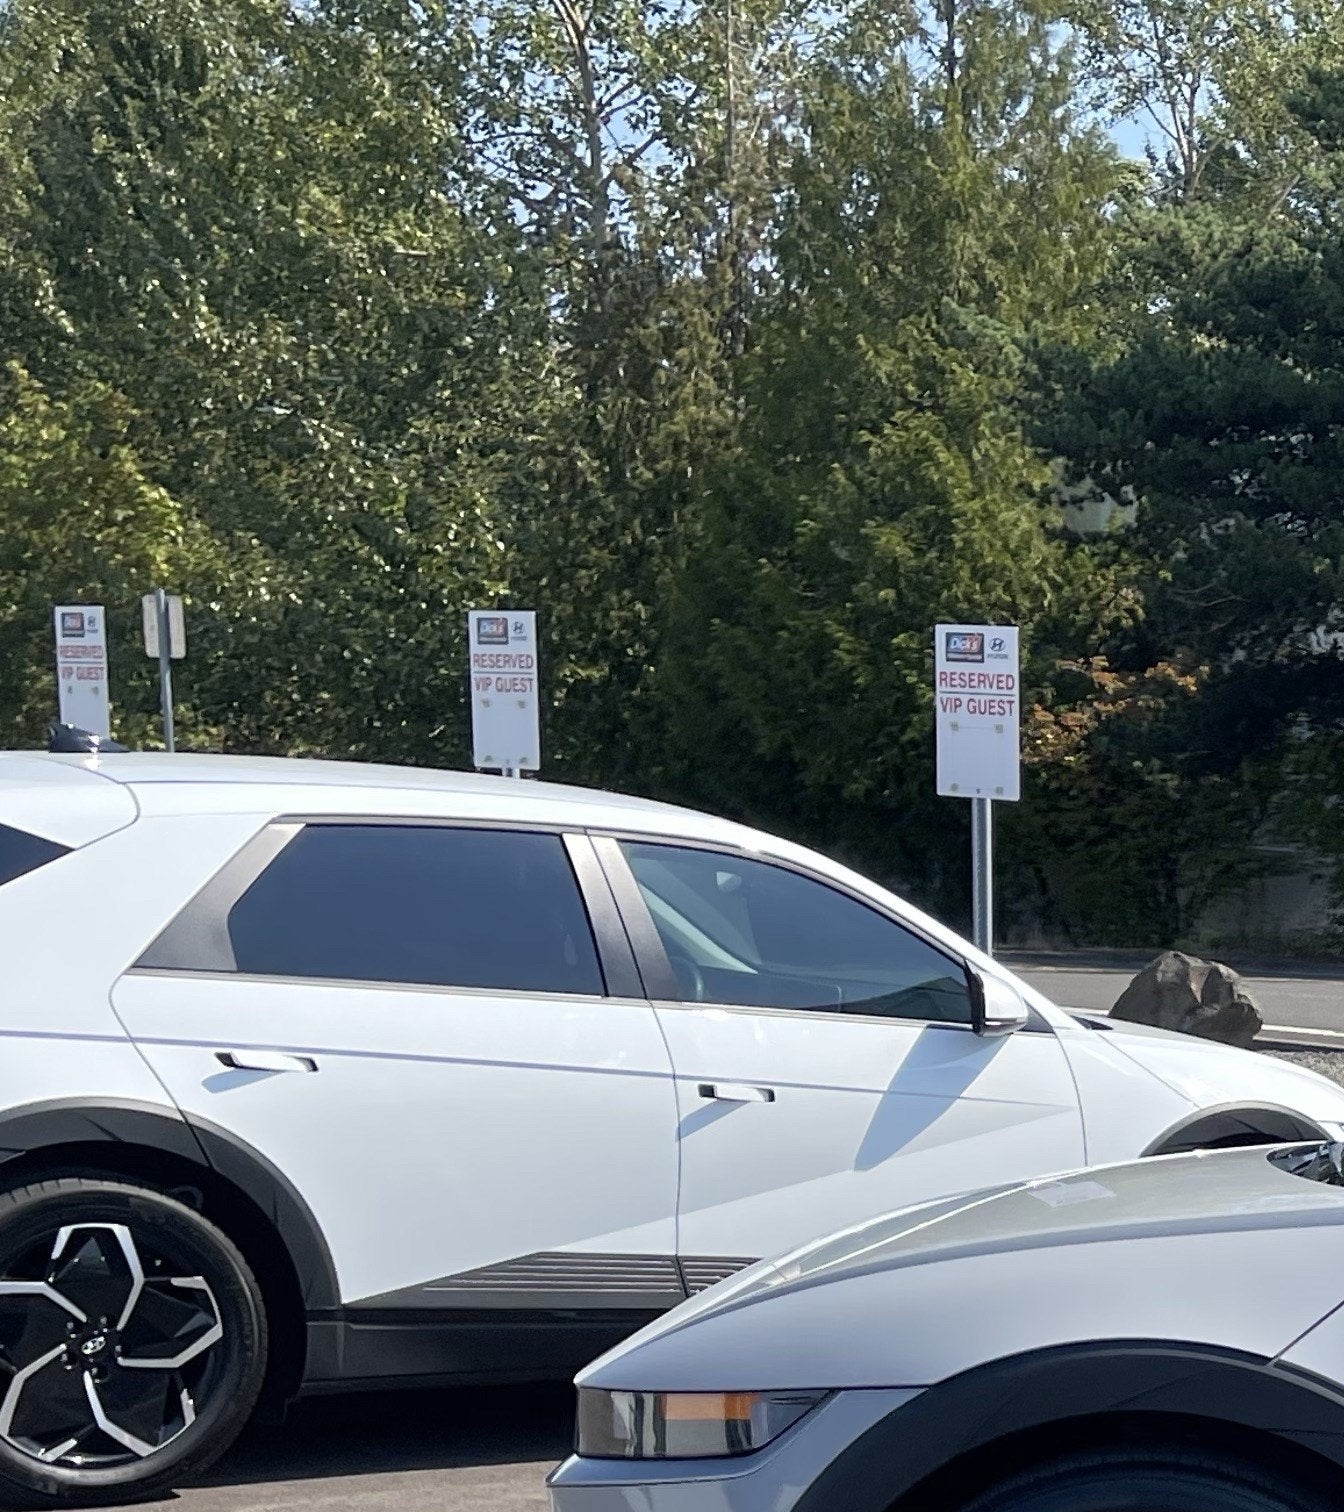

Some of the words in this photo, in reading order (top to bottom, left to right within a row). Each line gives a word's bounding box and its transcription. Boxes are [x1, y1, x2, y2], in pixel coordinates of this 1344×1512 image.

[939, 671, 1015, 690] RESERVED
[940, 697, 963, 714] VIP
[967, 698, 1015, 717] GUEST
